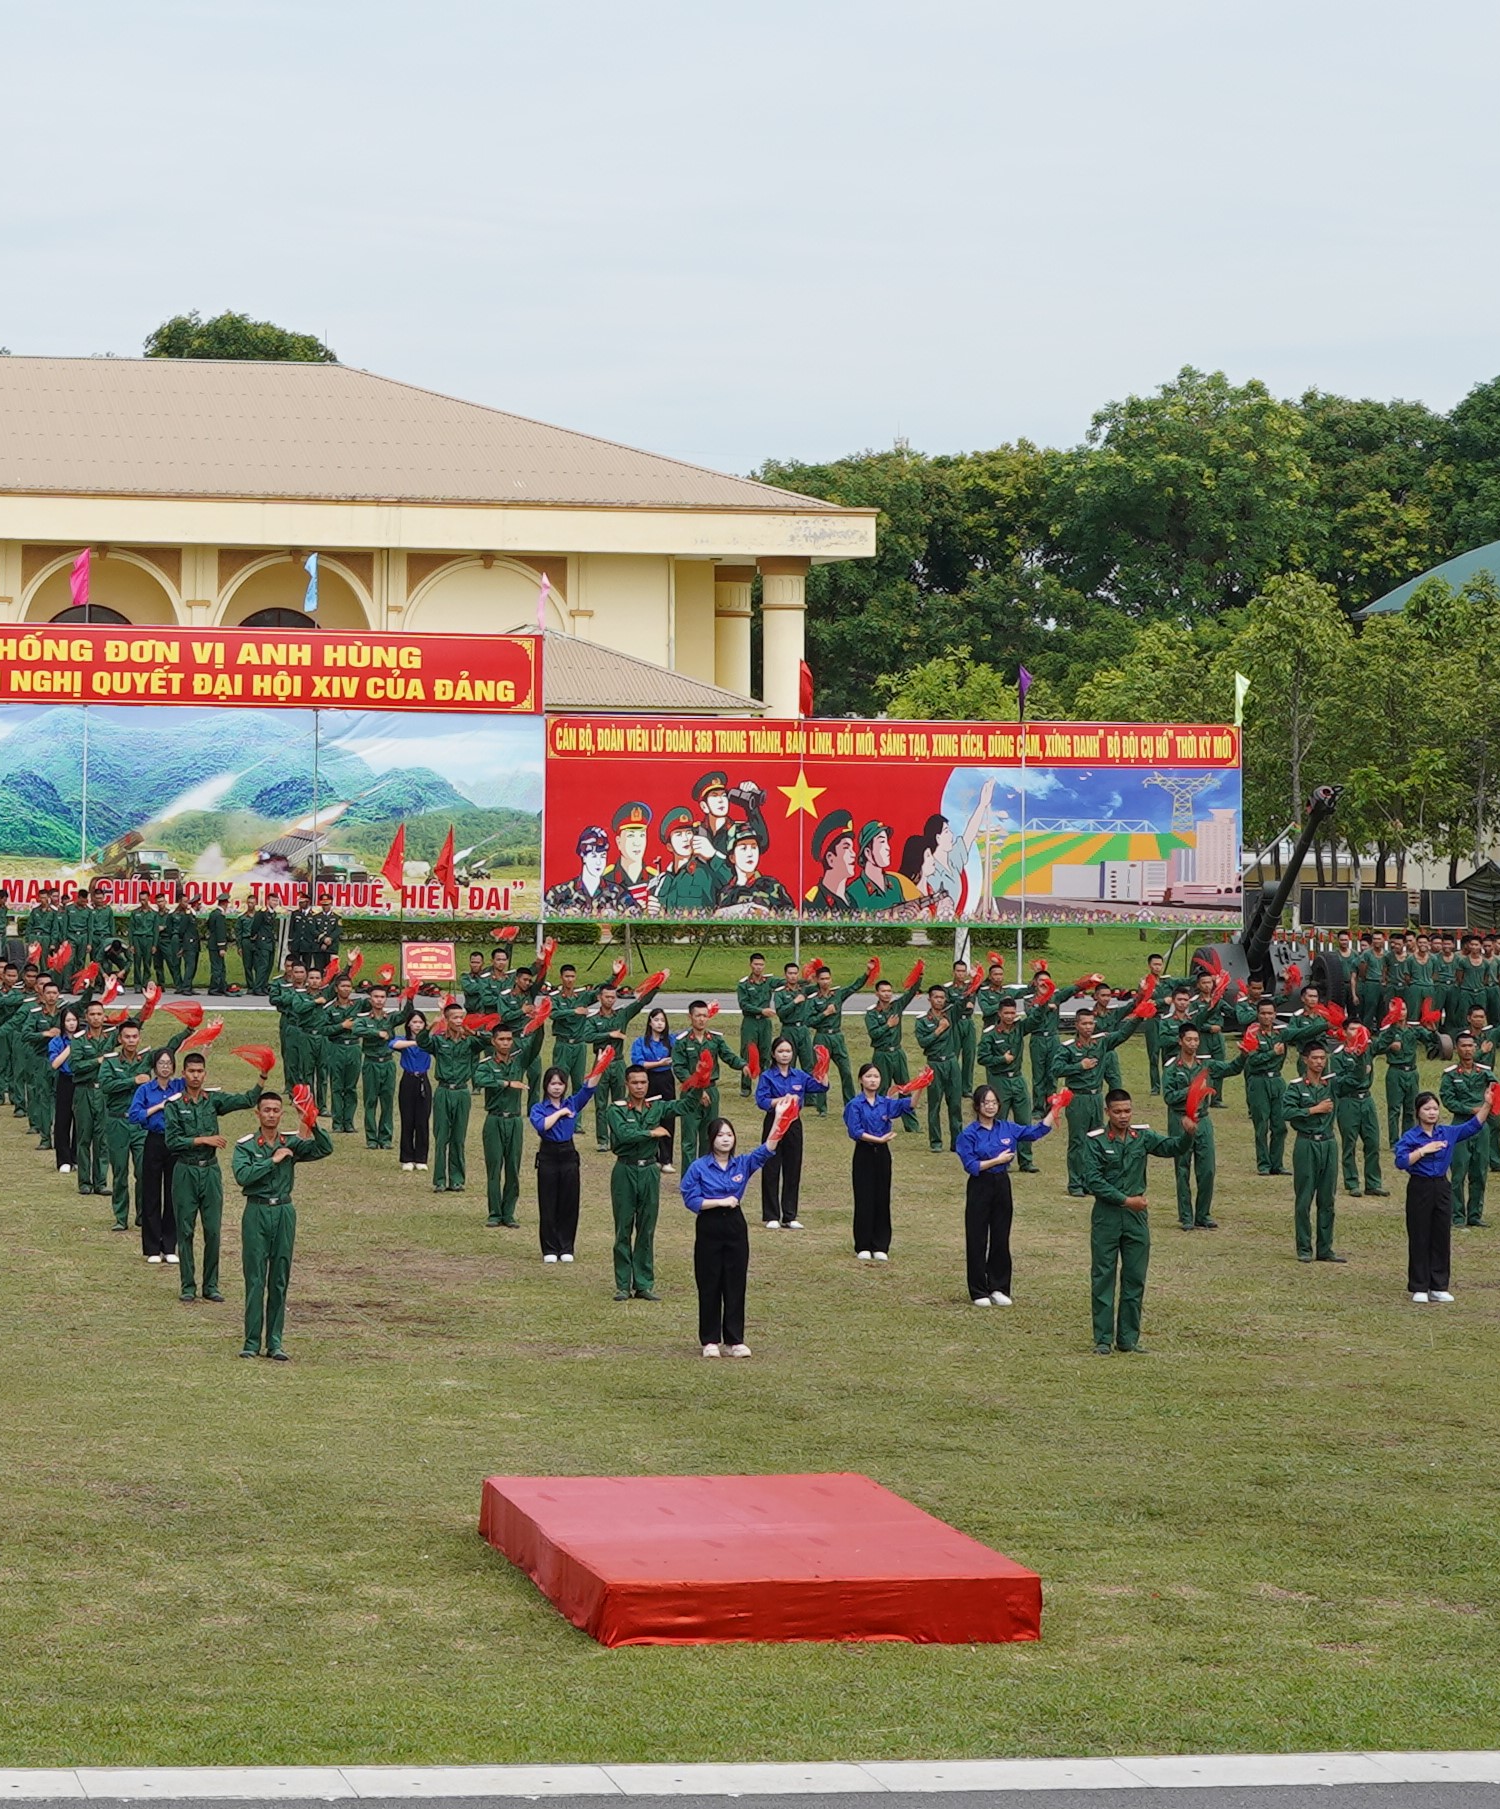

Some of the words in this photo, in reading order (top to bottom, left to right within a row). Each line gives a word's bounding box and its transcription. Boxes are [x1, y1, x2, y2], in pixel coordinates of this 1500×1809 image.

[104, 640, 179, 663] ĐƠN
[192, 642, 224, 668] VỊ
[237, 643, 311, 665] ANH
[324, 641, 421, 668] HÙNG
[11, 671, 81, 697] NGHỊ
[93, 666, 184, 695] QUYẾT
[193, 674, 242, 699] ĐẠI
[253, 671, 301, 700] HỘI
[312, 676, 359, 697] XIV
[367, 669, 425, 699] CỦA
[434, 671, 514, 701] ĐẢNG
[556, 724, 576, 750] CÁN
[579, 724, 595, 755] BỘ,
[597, 725, 624, 751] ĐOÀN
[626, 725, 649, 751] VIÊN
[651, 724, 664, 752] LỮ
[666, 726, 692, 752] ĐOÀN
[695, 730, 712, 752] 368
[715, 730, 746, 753] TRUNG
[749, 726, 783, 755] THÀNH,
[785, 721, 806, 754] BẢN
[810, 728, 834, 756] LĨNH,
[837, 723, 855, 755] ĐỔI
[856, 729, 877, 757] MỚI,
[880, 729, 906, 756] SÁNG
[909, 734, 929, 760] TẠO,
[932, 734, 958, 756] XUNG
[961, 731, 985, 759] KÍCH,
[988, 731, 1014, 757] DŨNG
[1045, 729, 1071, 757] XỨNG
[1107, 732, 1120, 762] BỘ
[1122, 732, 1138, 761] ĐỘI
[1141, 736, 1154, 761] CỤ
[1176, 731, 1197, 758] THỜI
[1199, 734, 1211, 758] KỲ
[1214, 729, 1234, 758] MỚI
[96, 875, 175, 904] CHÍNH
[250, 882, 308, 906] TINH
[317, 879, 391, 913] NHUỆ,
[402, 880, 459, 914] HIỆN
